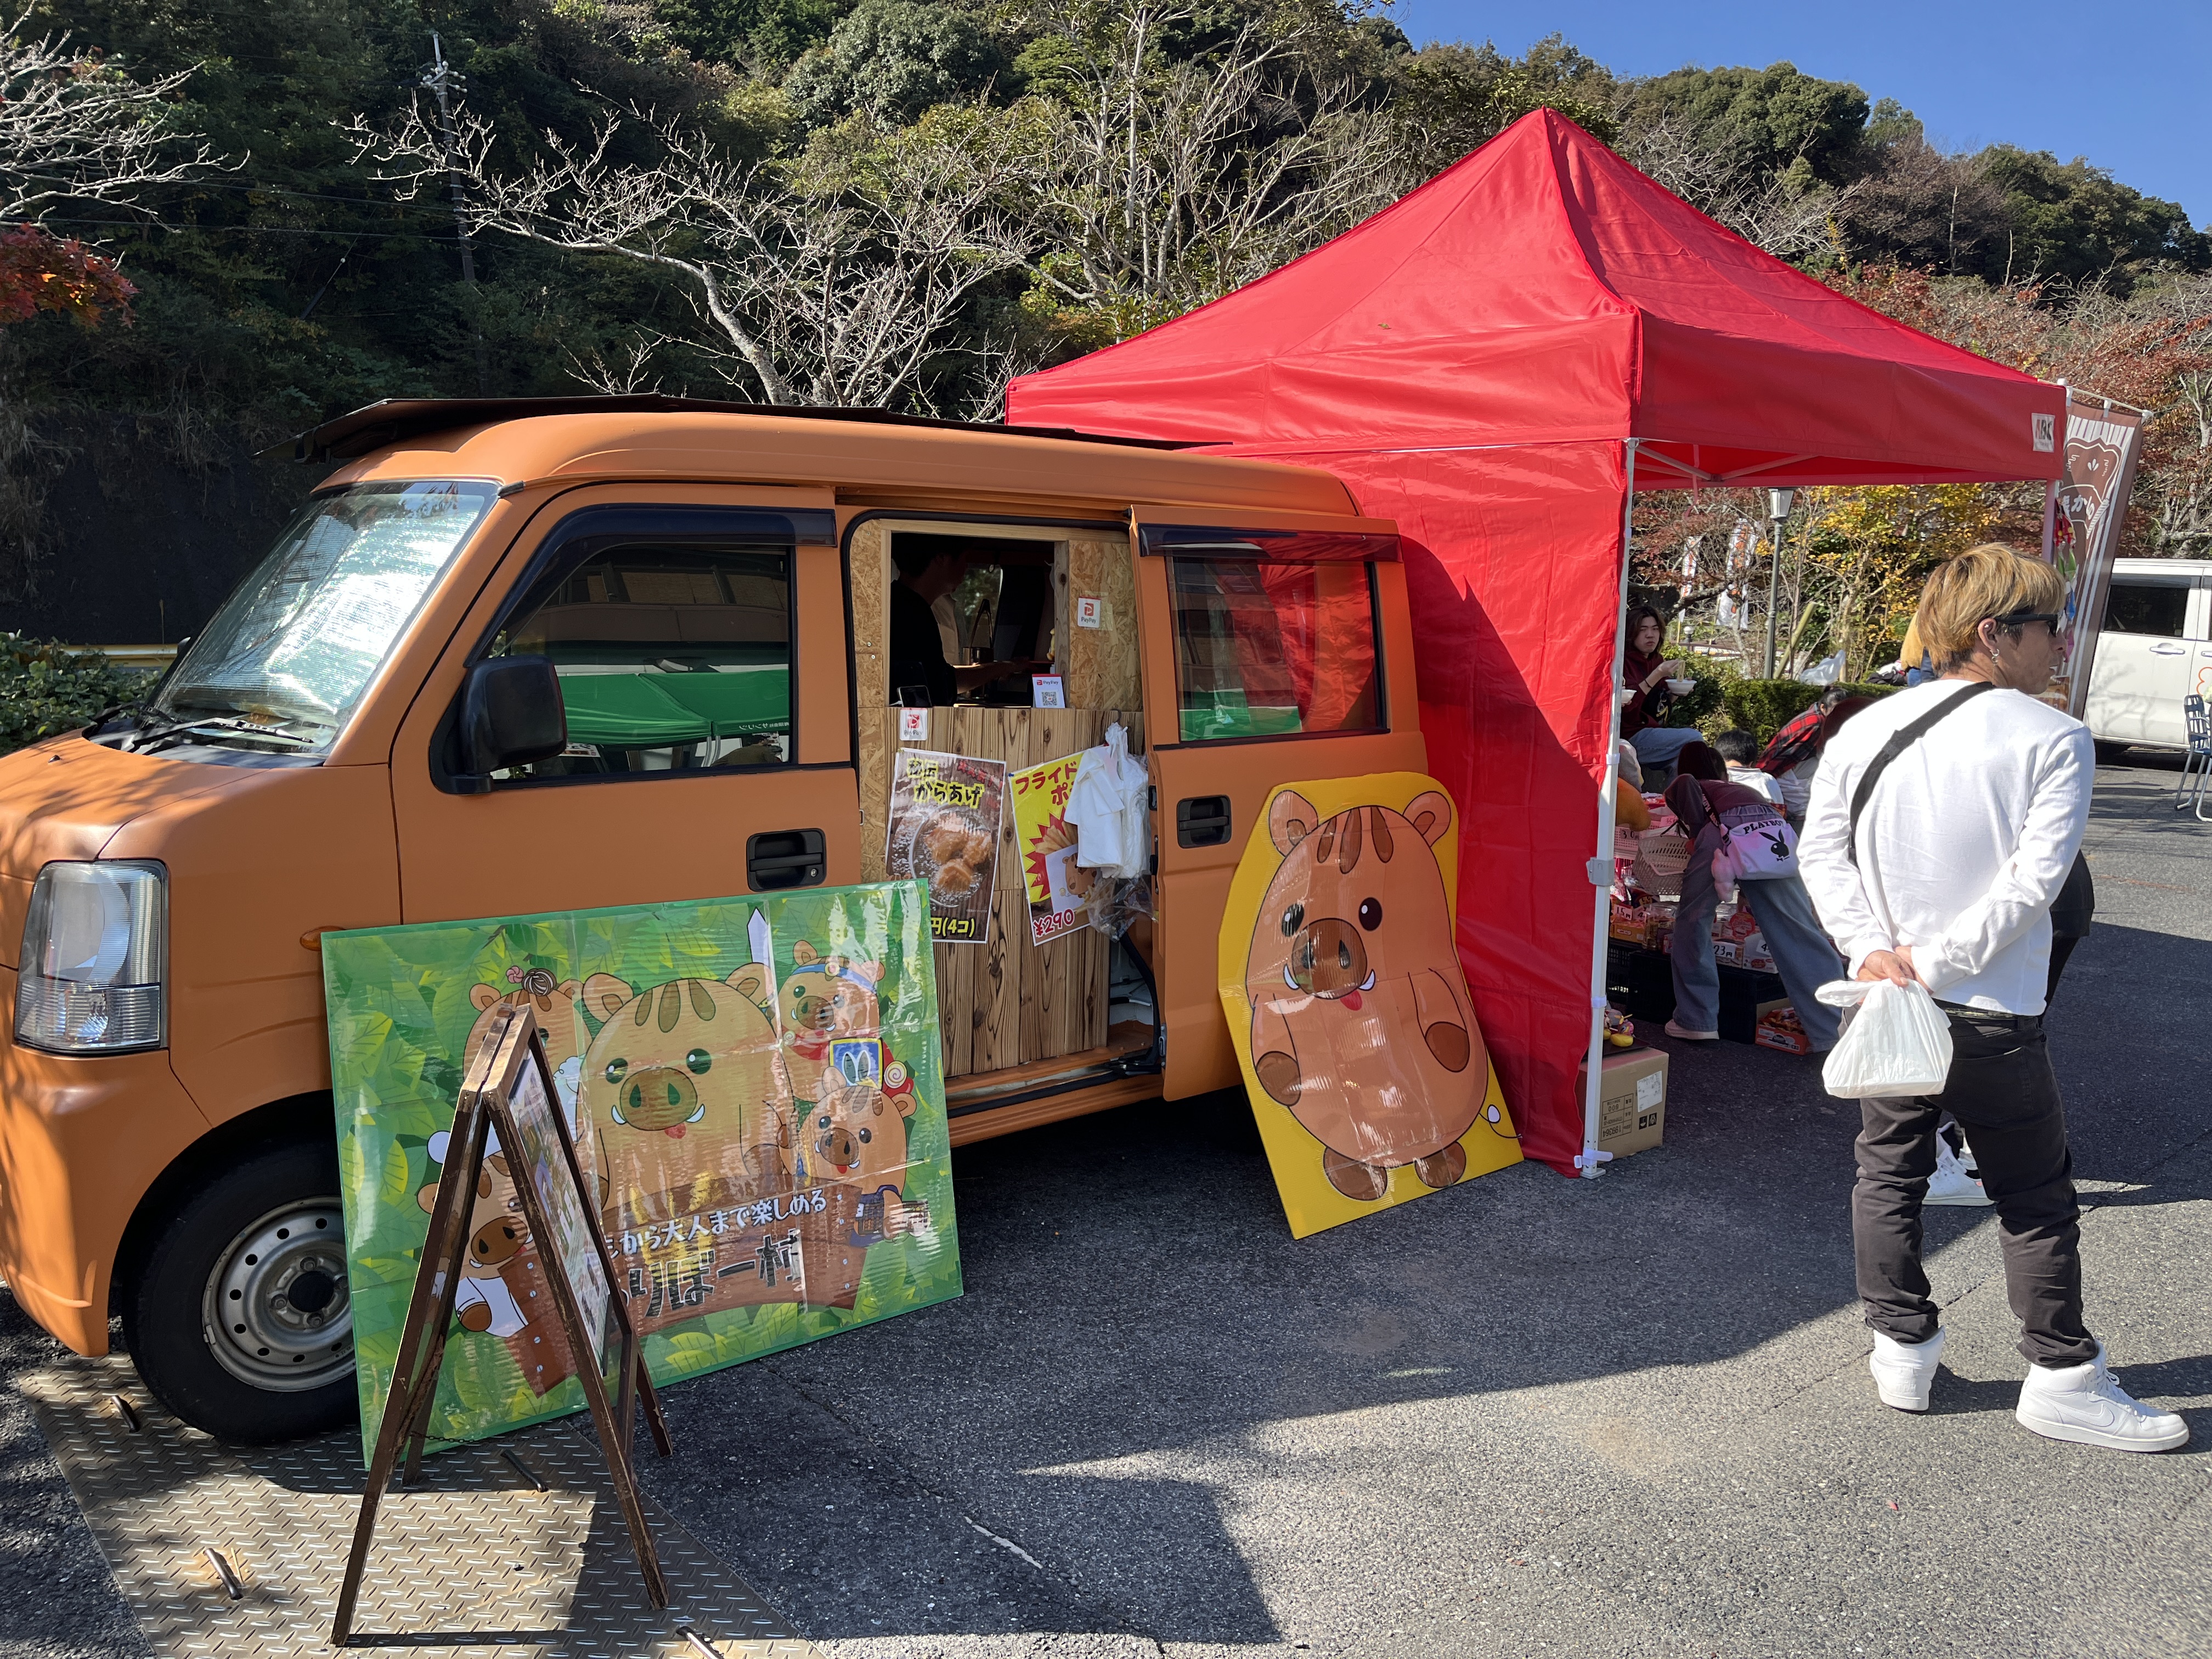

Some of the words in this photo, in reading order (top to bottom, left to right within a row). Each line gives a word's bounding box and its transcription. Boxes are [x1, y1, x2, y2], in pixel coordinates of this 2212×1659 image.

[1081, 616, 1097, 624] PayPay
[1015, 761, 1077, 795] フライド
[914, 780, 984, 808] からあげ
[1032, 908, 1075, 937] ¥290
[621, 1228, 801, 1318] りぼー村
